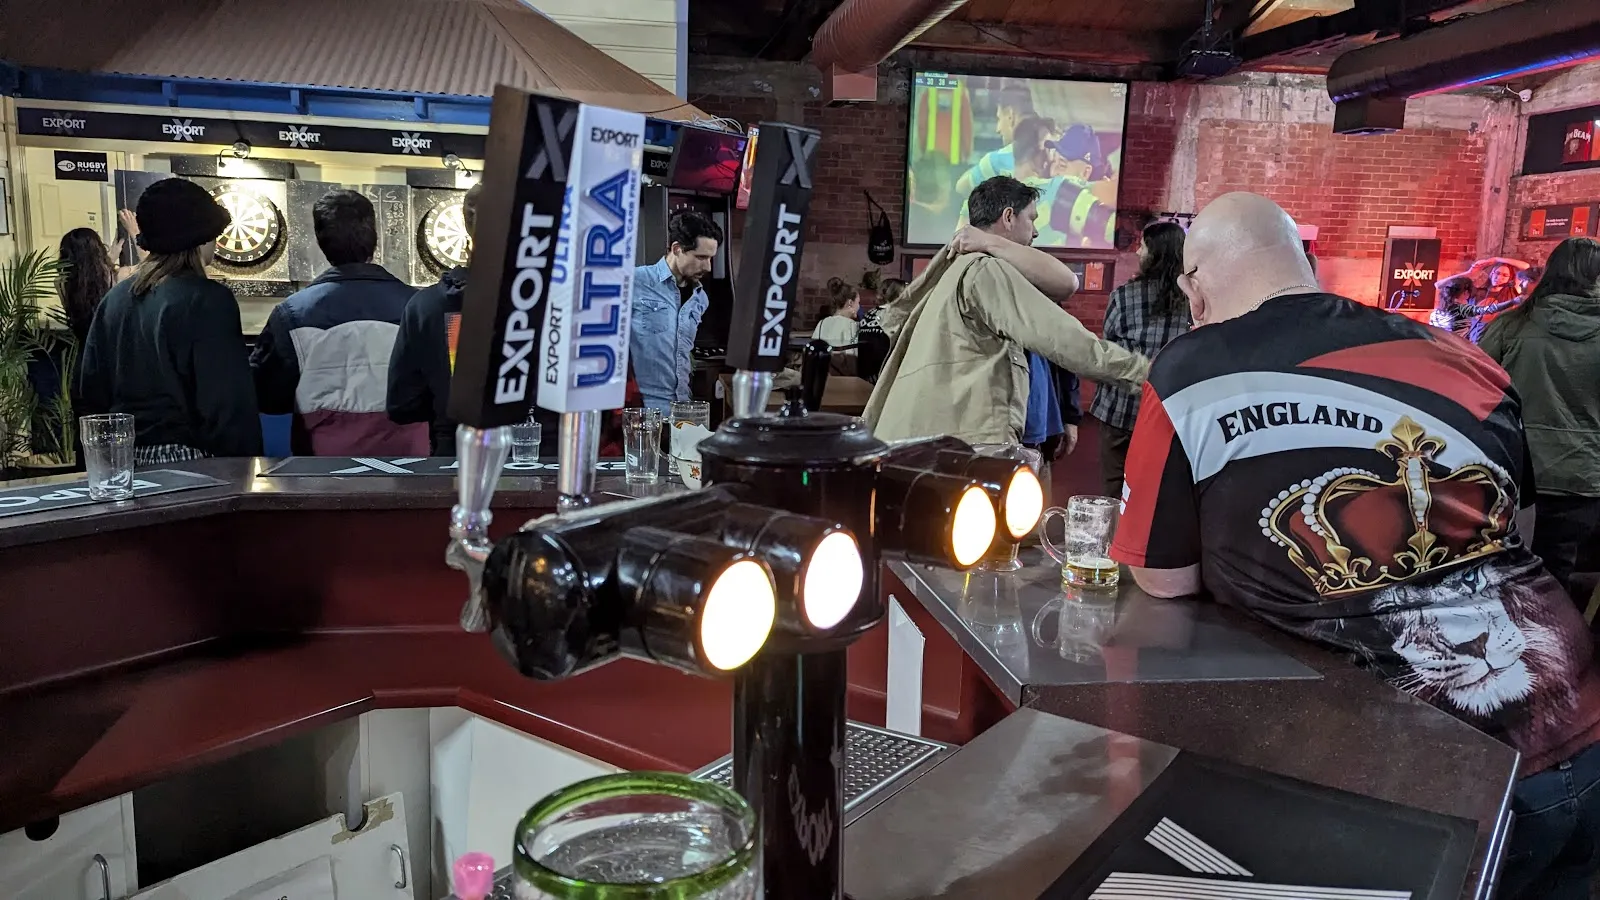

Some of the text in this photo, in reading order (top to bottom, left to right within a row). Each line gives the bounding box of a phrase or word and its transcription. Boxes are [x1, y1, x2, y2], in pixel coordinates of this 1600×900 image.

[42, 117, 86, 129] EXPORT
[162, 124, 205, 136] EXPORT
[278, 130, 321, 143] EXPORT
[391, 137, 432, 149] EXPORT
[591, 126, 640, 148] EXPORT
[77, 161, 106, 169] RUGBY
[650, 159, 669, 169] EXPO
[574, 168, 630, 388] ULTRA
[758, 203, 801, 357] EXPORT
[1394, 268, 1435, 280] EXPORT
[494, 203, 554, 404] EXPORT
[545, 302, 564, 386] EXPORT
[1216, 401, 1383, 444] ENGLAND
